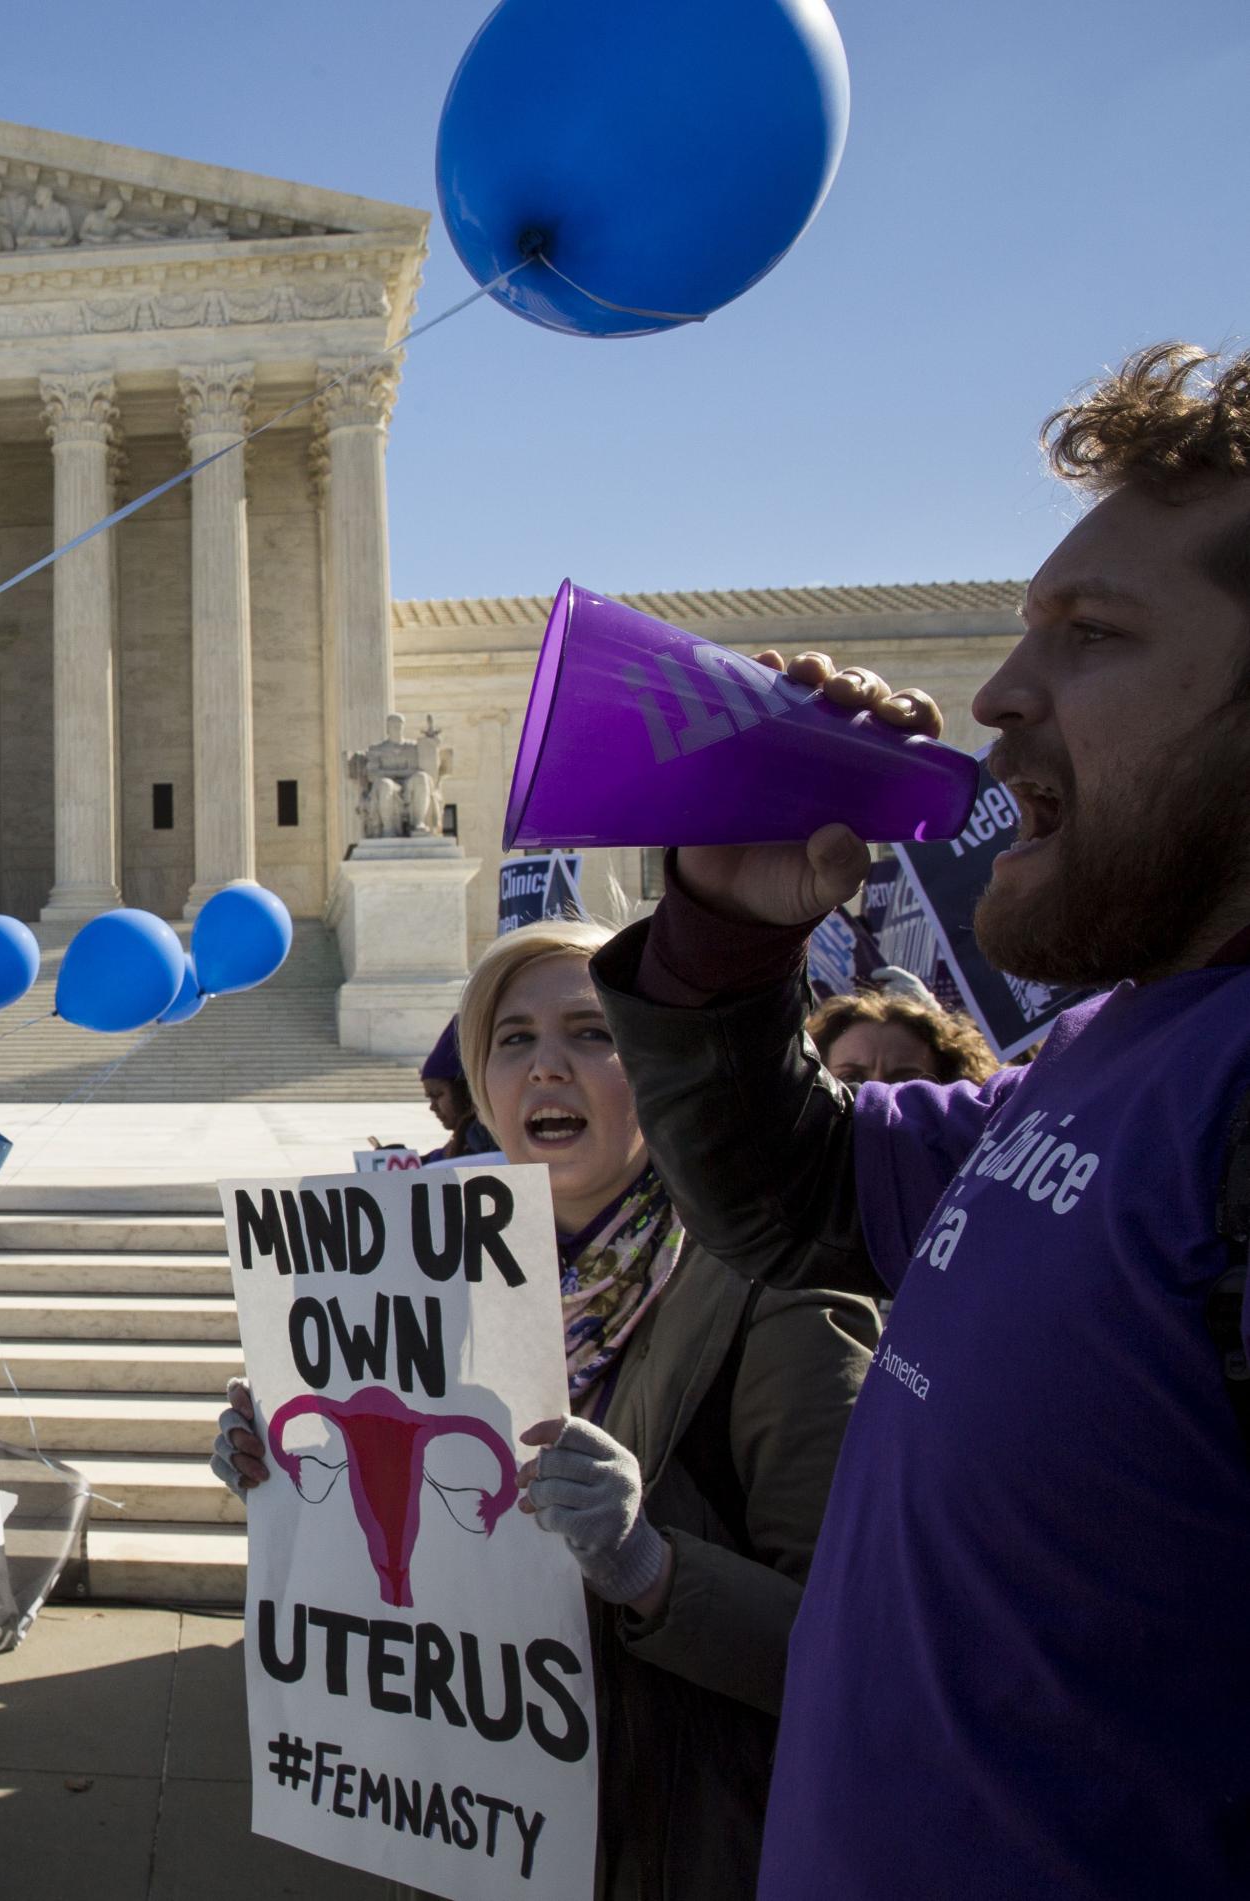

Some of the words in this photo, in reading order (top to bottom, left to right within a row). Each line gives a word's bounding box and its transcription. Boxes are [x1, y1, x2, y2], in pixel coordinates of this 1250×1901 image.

[3, 311, 56, 333] LAW
[235, 1187, 386, 1276] MIND
[411, 1175, 527, 1288] UR
[289, 1292, 446, 1398] OWN
[879, 1343, 930, 1400] America
[258, 1600, 590, 1763] UTERUS
[267, 1732, 546, 1880] #FEMNASTY
